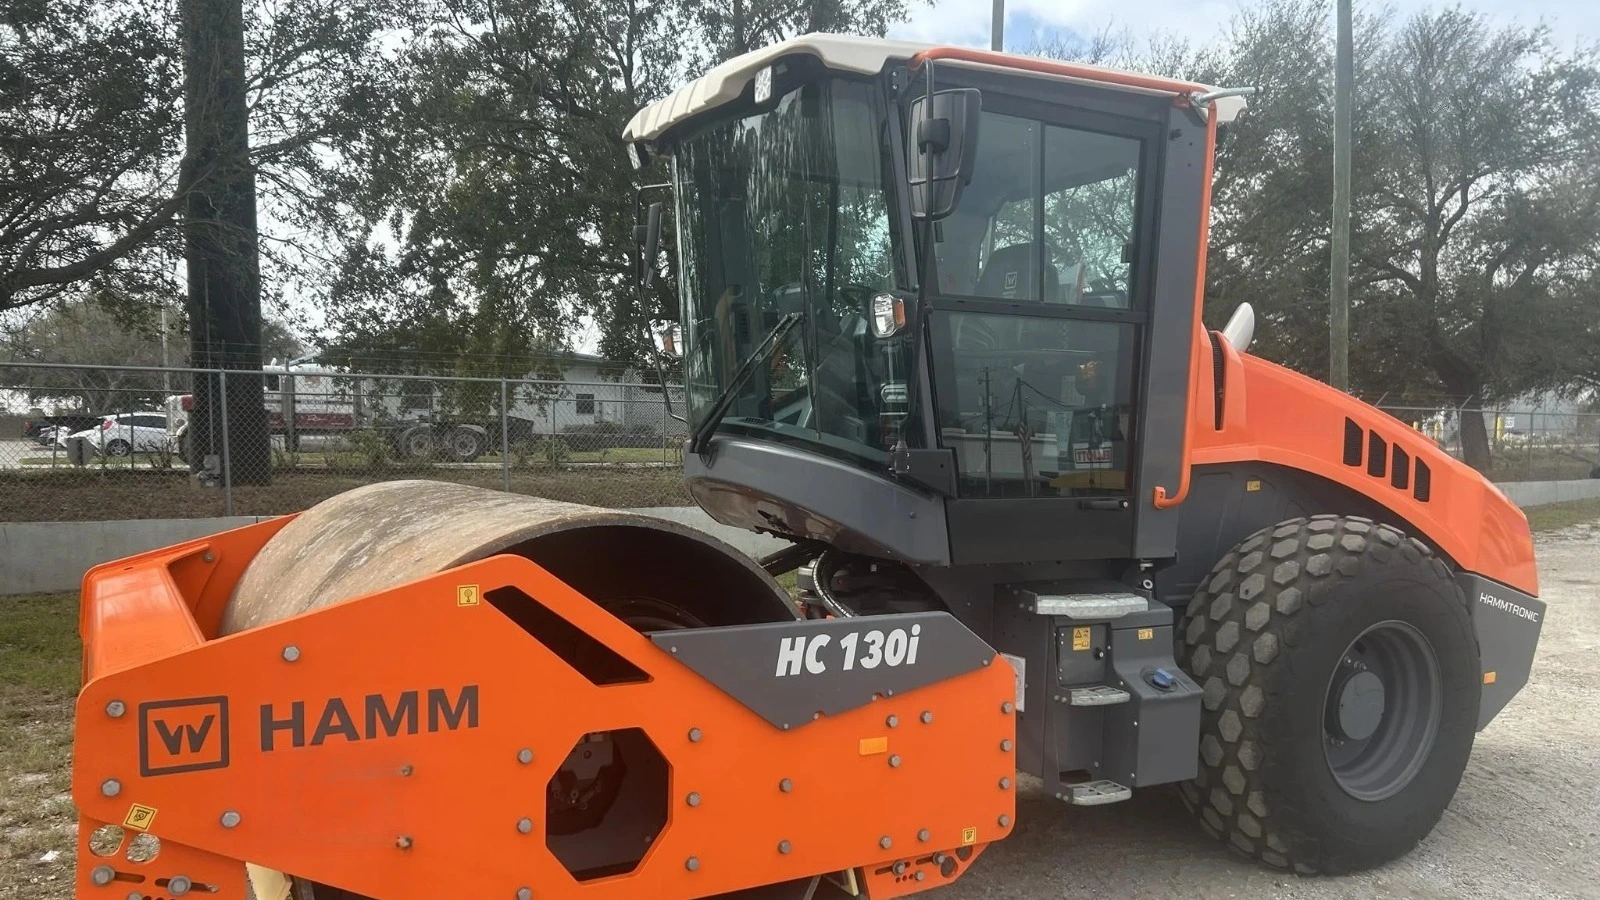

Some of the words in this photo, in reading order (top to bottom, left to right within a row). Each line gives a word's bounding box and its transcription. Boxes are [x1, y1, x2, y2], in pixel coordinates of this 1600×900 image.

[1479, 592, 1539, 623] HAMMTRONIC
[775, 634, 831, 677] HC
[839, 623, 921, 671] 130i
[260, 685, 479, 752] HAMM
